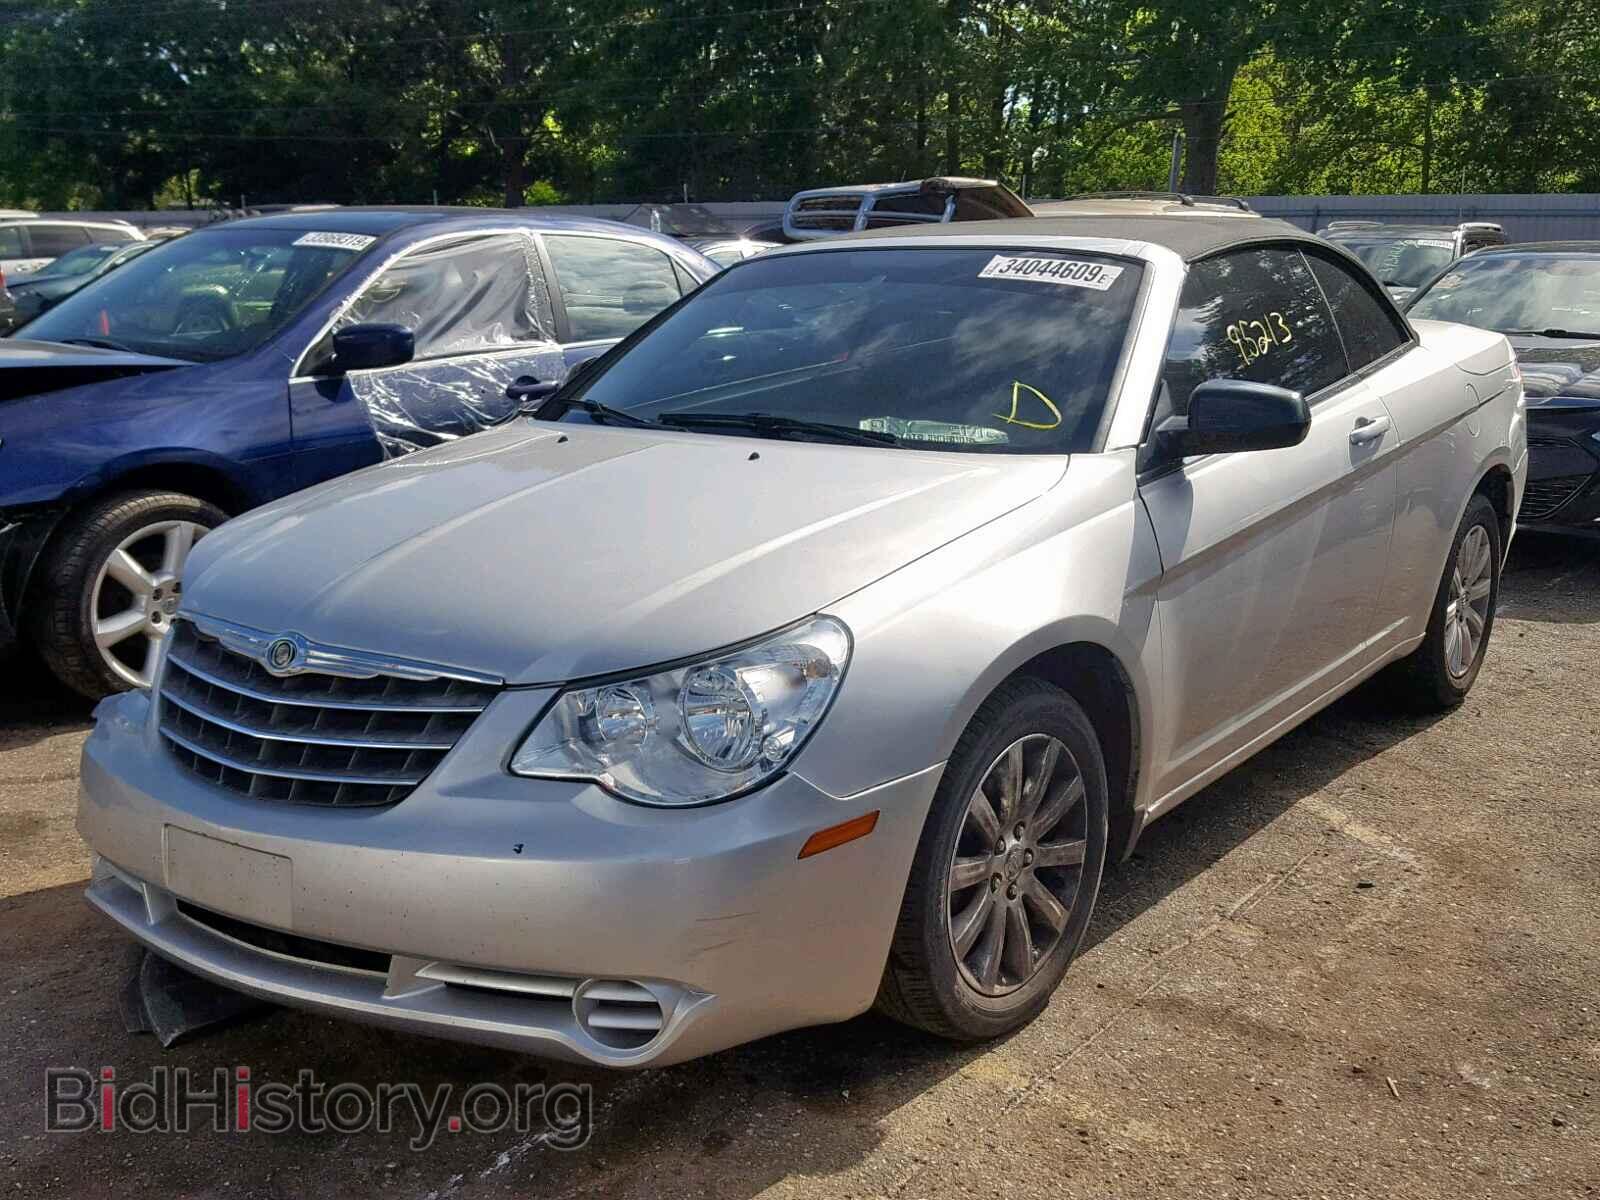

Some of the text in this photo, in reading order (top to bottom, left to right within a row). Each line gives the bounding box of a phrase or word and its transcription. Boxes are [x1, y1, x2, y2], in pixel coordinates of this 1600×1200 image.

[999, 258, 1103, 282] 34044609
[1226, 312, 1292, 365] 95213
[992, 382, 1062, 430] D
